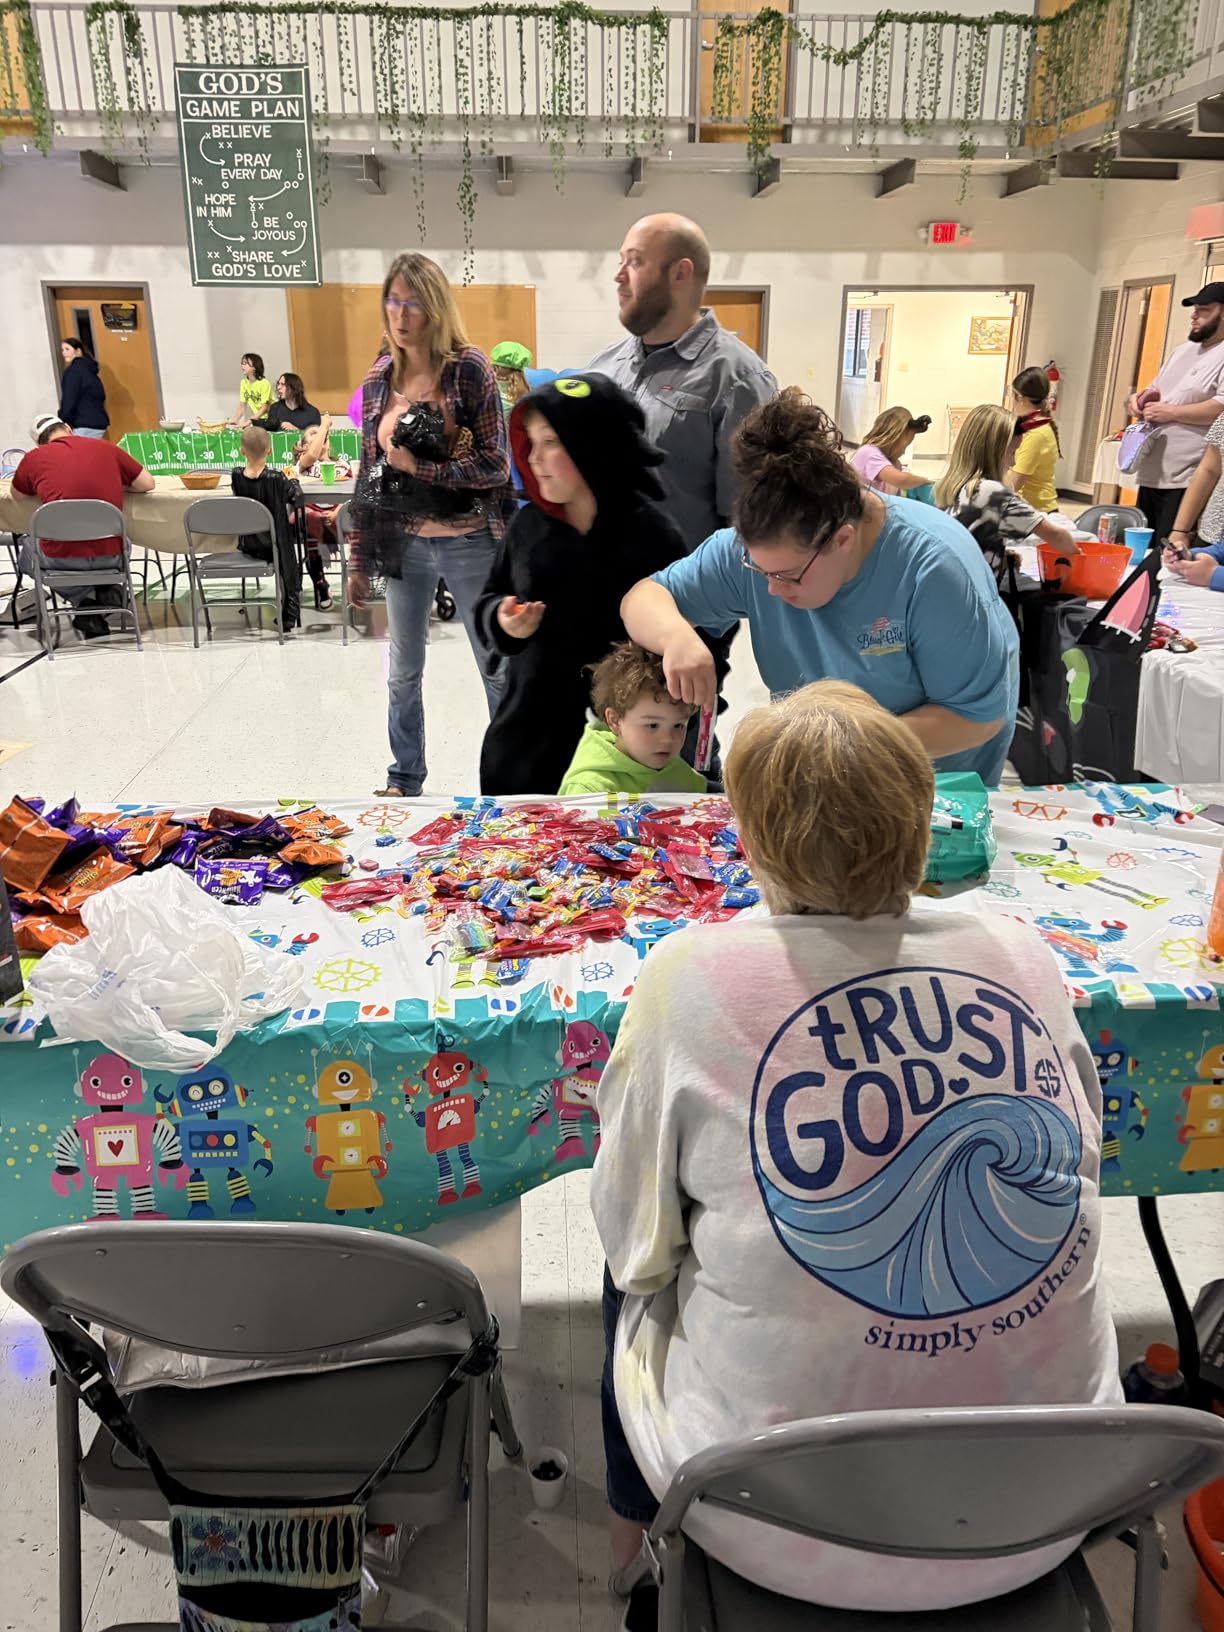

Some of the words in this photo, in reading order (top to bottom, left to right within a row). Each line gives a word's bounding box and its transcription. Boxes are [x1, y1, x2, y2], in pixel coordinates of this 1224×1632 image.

[198, 72, 283, 95] GOD'S
[186, 100, 241, 118] GAME
[251, 101, 300, 117] PLAN
[211, 124, 272, 139] BELIEVE
[234, 154, 272, 167] PRAY
[221, 168, 256, 180] EVERY
[260, 169, 283, 180] DAY
[204, 194, 236, 206] HOPE
[196, 206, 208, 217] IN
[210, 206, 233, 218] HIM
[263, 217, 280, 228] BE
[251, 230, 296, 241] JOYOUS
[232, 251, 275, 263] SHARE
[212, 263, 257, 278] GOD'S
[264, 264, 302, 278] LOVE
[864, 1321, 986, 1358] simply
[992, 1228, 1091, 1336] southern
